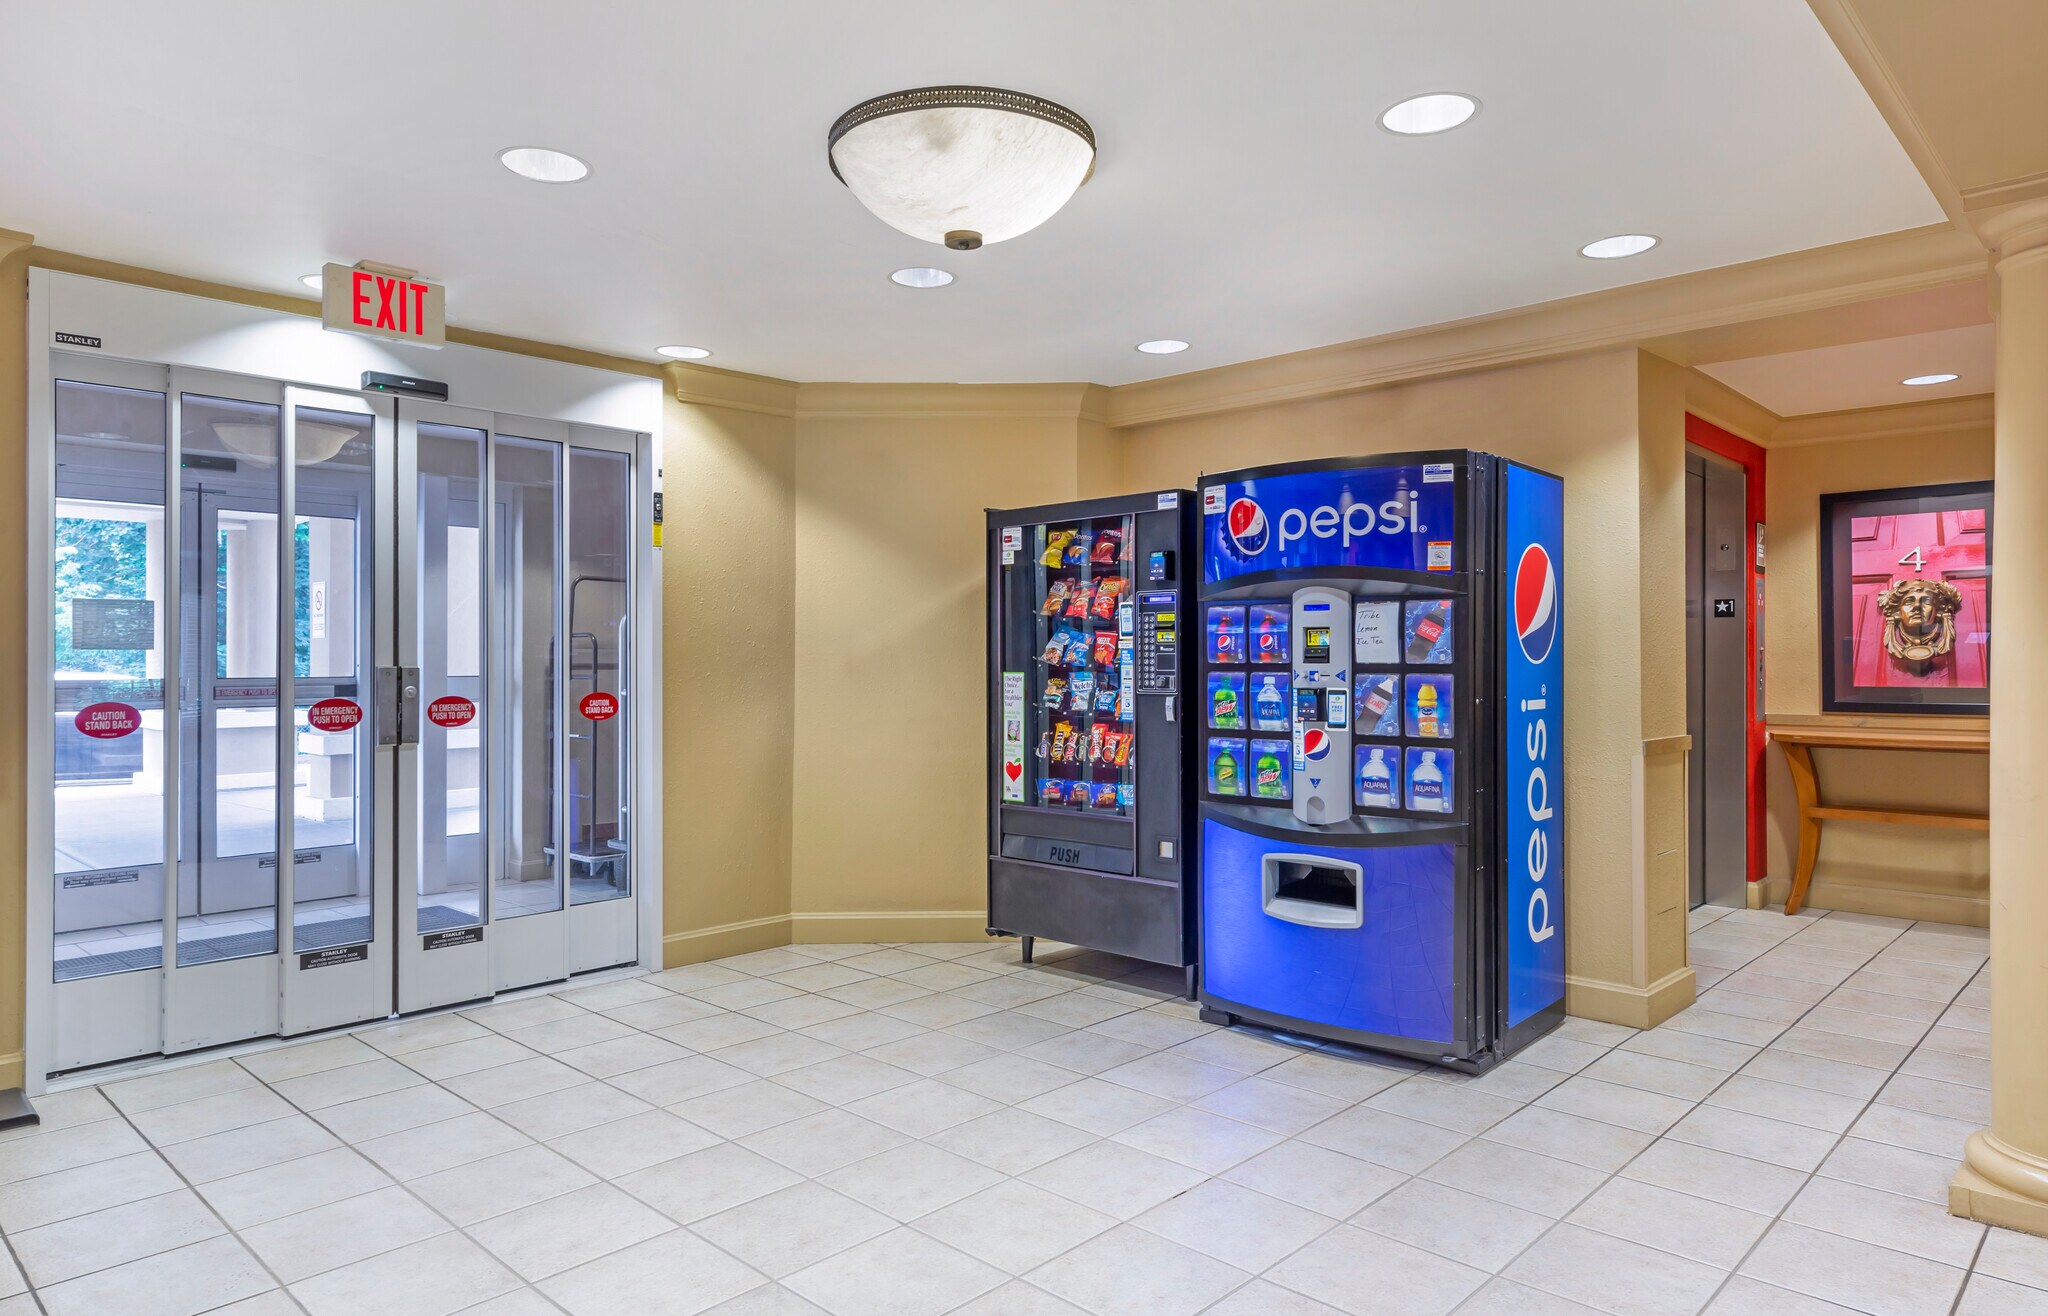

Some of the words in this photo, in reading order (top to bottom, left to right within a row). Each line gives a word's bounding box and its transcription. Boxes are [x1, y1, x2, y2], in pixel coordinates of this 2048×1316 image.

[352, 271, 429, 336] EXIT
[57, 334, 99, 346] STANLEY
[1278, 490, 1419, 552] pepsi
[1898, 546, 1928, 572] 4
[1358, 610, 1380, 619] Tribe
[1357, 624, 1378, 633] Lemon
[1370, 636, 1384, 644] Tea
[321, 706, 358, 715] EMERGENCY
[438, 704, 472, 712] EMERGENCY
[92, 711, 126, 720] CAUTION
[313, 716, 330, 724] PUSH
[331, 716, 340, 724] TO
[341, 715, 358, 723] OPEN
[432, 712, 448, 720] PUSH
[448, 712, 456, 720] TO
[456, 711, 472, 719] OPEN
[85, 721, 110, 730] STAND
[112, 720, 133, 729] BACK
[1364, 780, 1388, 790] AQUAFINA
[1414, 784, 1440, 794] AQUAFINA
[1520, 699, 1554, 943] pepsi
[1050, 846, 1080, 864] PUSH
[442, 930, 466, 938] STANLEY
[321, 949, 348, 957] STANLEY
